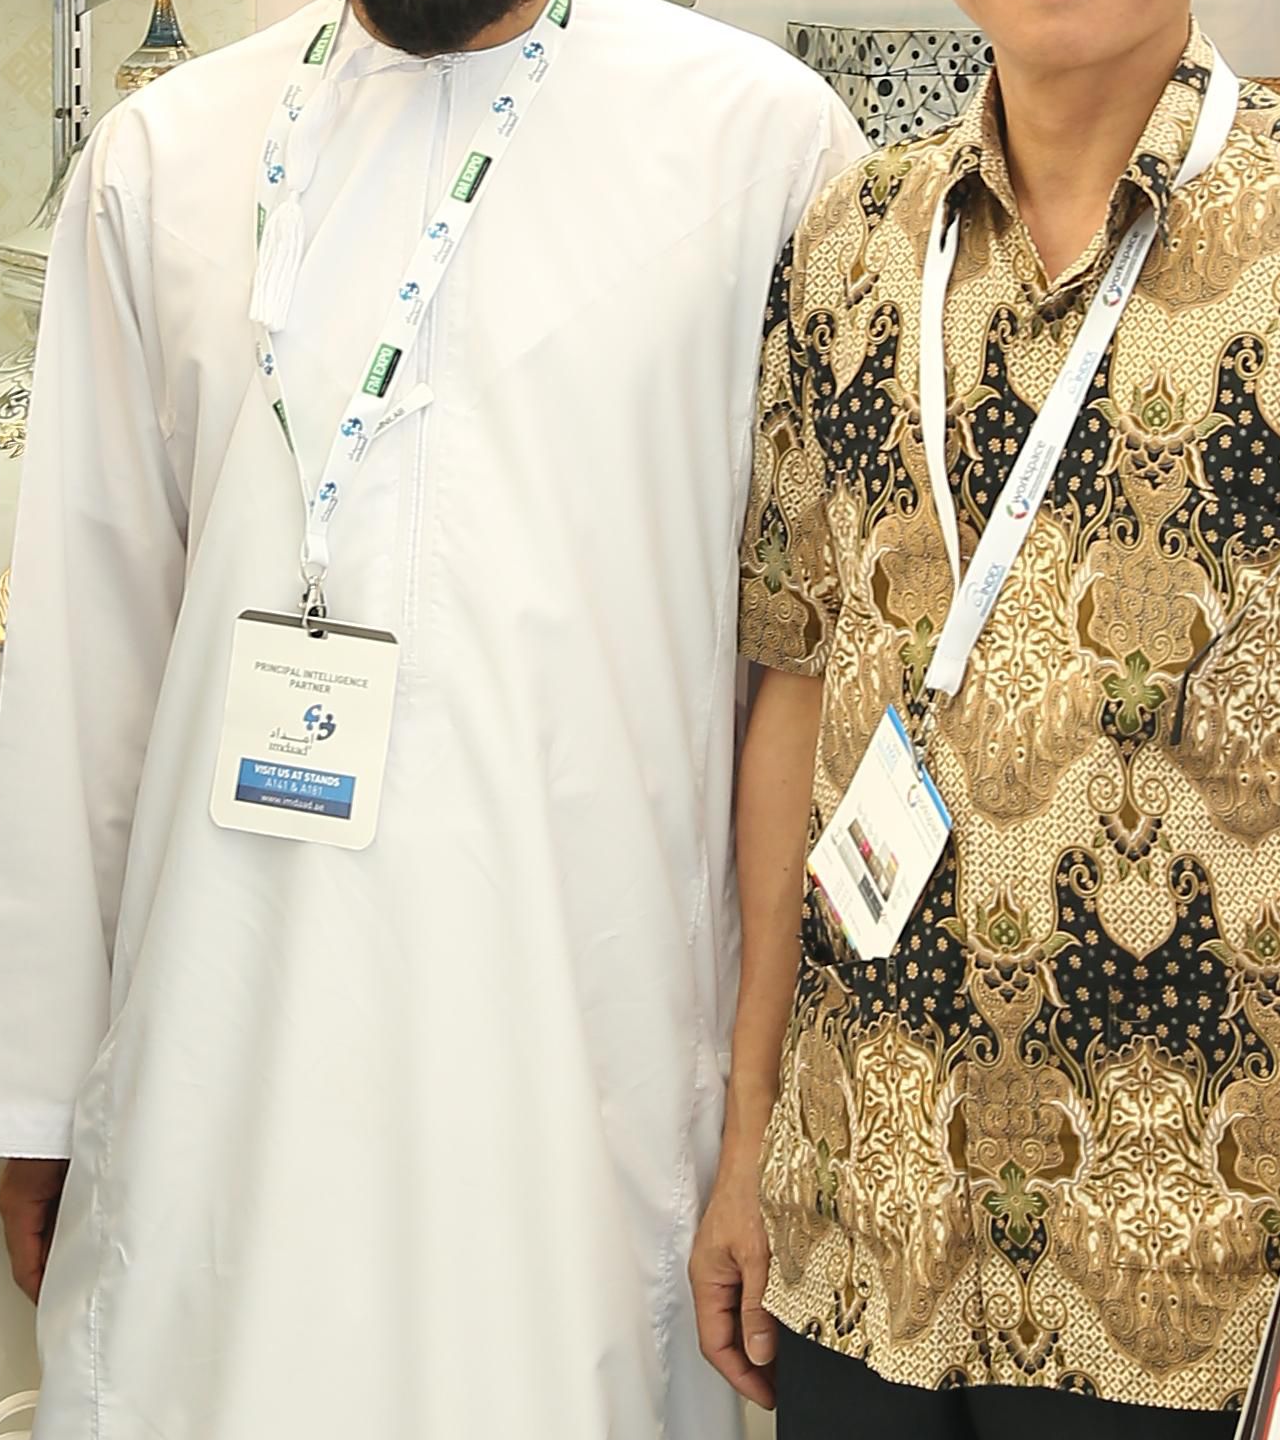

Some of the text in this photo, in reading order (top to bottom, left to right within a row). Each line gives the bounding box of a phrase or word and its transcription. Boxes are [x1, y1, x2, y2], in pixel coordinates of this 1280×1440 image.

[461, 155, 483, 182] EXPO
[372, 347, 394, 376] EXPO
[255, 661, 369, 688] PRINCIPAL INTELLIGENCE
[289, 679, 332, 694] PARTNER
[254, 763, 341, 788] VISIT US AT STANDS
